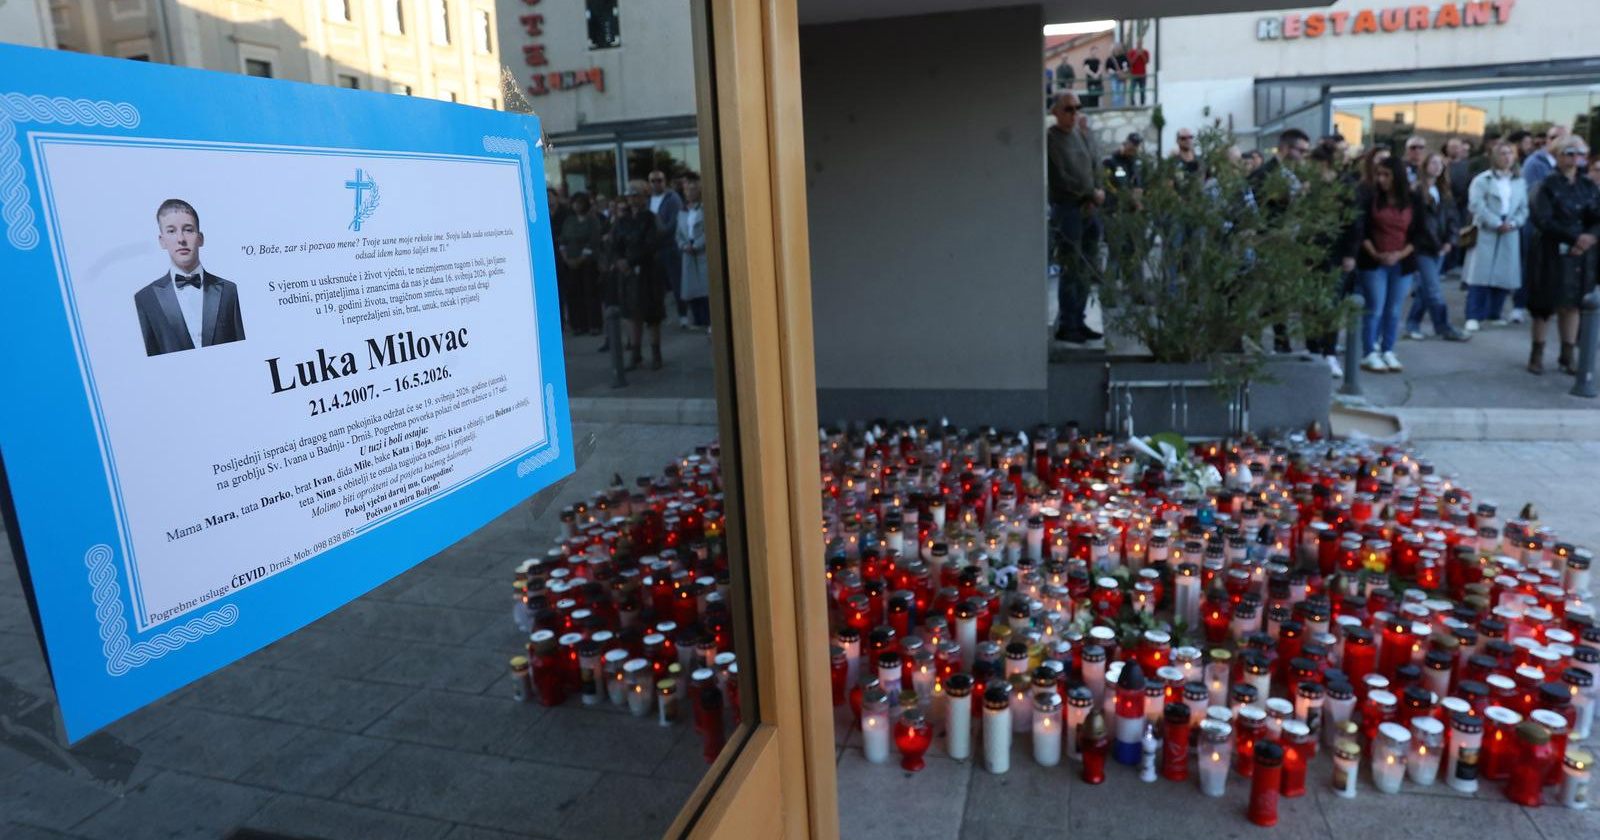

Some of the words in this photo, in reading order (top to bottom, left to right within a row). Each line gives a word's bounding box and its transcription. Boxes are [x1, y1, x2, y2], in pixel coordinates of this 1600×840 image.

[1257, 0, 1515, 41] RESTAURANT
[259, 245, 282, 254] Bože,
[300, 242, 306, 252] si
[308, 242, 336, 253] pozvao
[337, 238, 360, 248] mene?
[362, 238, 381, 248] Tvoje
[399, 236, 413, 245] moje
[414, 234, 432, 242] rekoše
[355, 249, 376, 260] odsad
[377, 249, 393, 258] idem
[394, 248, 412, 256] kamo
[269, 281, 275, 292] S
[277, 280, 309, 292] vjerom
[318, 272, 357, 286] uskrsnuće
[359, 272, 362, 281] i
[364, 271, 382, 280] život
[384, 267, 407, 280] vječni,
[471, 259, 474, 267] i
[278, 292, 313, 305] rodbini,
[315, 287, 360, 303] prijateljima
[361, 285, 364, 294] i
[366, 282, 400, 293] znancima
[401, 280, 410, 289] da
[422, 277, 429, 288] je
[430, 276, 444, 285] dana
[445, 273, 454, 282] 16.
[324, 303, 336, 314] 19.
[338, 299, 362, 314] godini
[364, 297, 388, 307] života,
[389, 292, 423, 304] tragičnom
[342, 315, 345, 325] i
[347, 308, 391, 325] neprežaljeni
[392, 306, 405, 316] sin,
[405, 305, 421, 314] brat,
[457, 296, 460, 305] i
[265, 348, 358, 394] Luka
[365, 328, 468, 370] Milovac
[309, 384, 379, 416] 21.4.2007.
[395, 366, 452, 392] 16.5.2026.
[212, 451, 261, 475] Posljednji
[263, 439, 297, 459] ispraćaj
[299, 433, 328, 447] dragog
[329, 427, 346, 438] nam
[346, 415, 382, 434] pokojnika
[383, 408, 405, 420] održat
[424, 398, 434, 408] 19.
[217, 480, 229, 490] na
[232, 467, 266, 488] groblju
[267, 462, 282, 473] Sv.
[284, 454, 308, 467] Ivana
[316, 440, 345, 456] Badnju
[374, 421, 407, 436] Pogrebna
[408, 411, 434, 428] povorka
[435, 403, 453, 419] polazi
[453, 401, 460, 410] od
[360, 445, 366, 456] U
[368, 440, 382, 453] tuzi
[384, 438, 387, 448] i
[389, 433, 403, 446] boli
[404, 426, 428, 440] ostaju:
[166, 524, 202, 542] Mama
[205, 512, 239, 528] Mara,
[241, 503, 259, 515] tata
[260, 491, 293, 507] Darko,
[294, 482, 312, 494] brat
[313, 475, 335, 487] Ivan,
[336, 466, 353, 479] dida
[354, 460, 373, 472] Mile,
[374, 452, 390, 464] bake
[392, 446, 410, 457] Kata
[411, 442, 414, 451] i
[415, 438, 433, 449] Boja,
[448, 427, 462, 437] Ivica
[299, 497, 315, 508] teta
[316, 488, 336, 501] Nina
[344, 472, 369, 490] obitelji
[378, 462, 398, 476] ostala
[312, 500, 341, 518] Molimo
[343, 492, 355, 505] biti
[356, 478, 388, 500] oprošteni
[390, 473, 399, 485] od
[400, 466, 423, 483] posjeta
[345, 501, 366, 517] Pokoj
[367, 492, 387, 508] vječni
[388, 484, 407, 498] daruj
[408, 481, 420, 490] mu,
[421, 464, 454, 484] Gospodine!
[366, 505, 392, 521] Počivao
[399, 494, 415, 506] miru
[416, 481, 440, 498] Božjem!
[150, 599, 198, 624] Pogrebne
[200, 585, 229, 603] usluge
[232, 566, 268, 588] ĆEVID,
[269, 556, 293, 573] Drniš,
[294, 548, 312, 562] Mob:
[313, 540, 327, 553] 098
[328, 534, 341, 546] 838
[342, 527, 355, 539] 885
